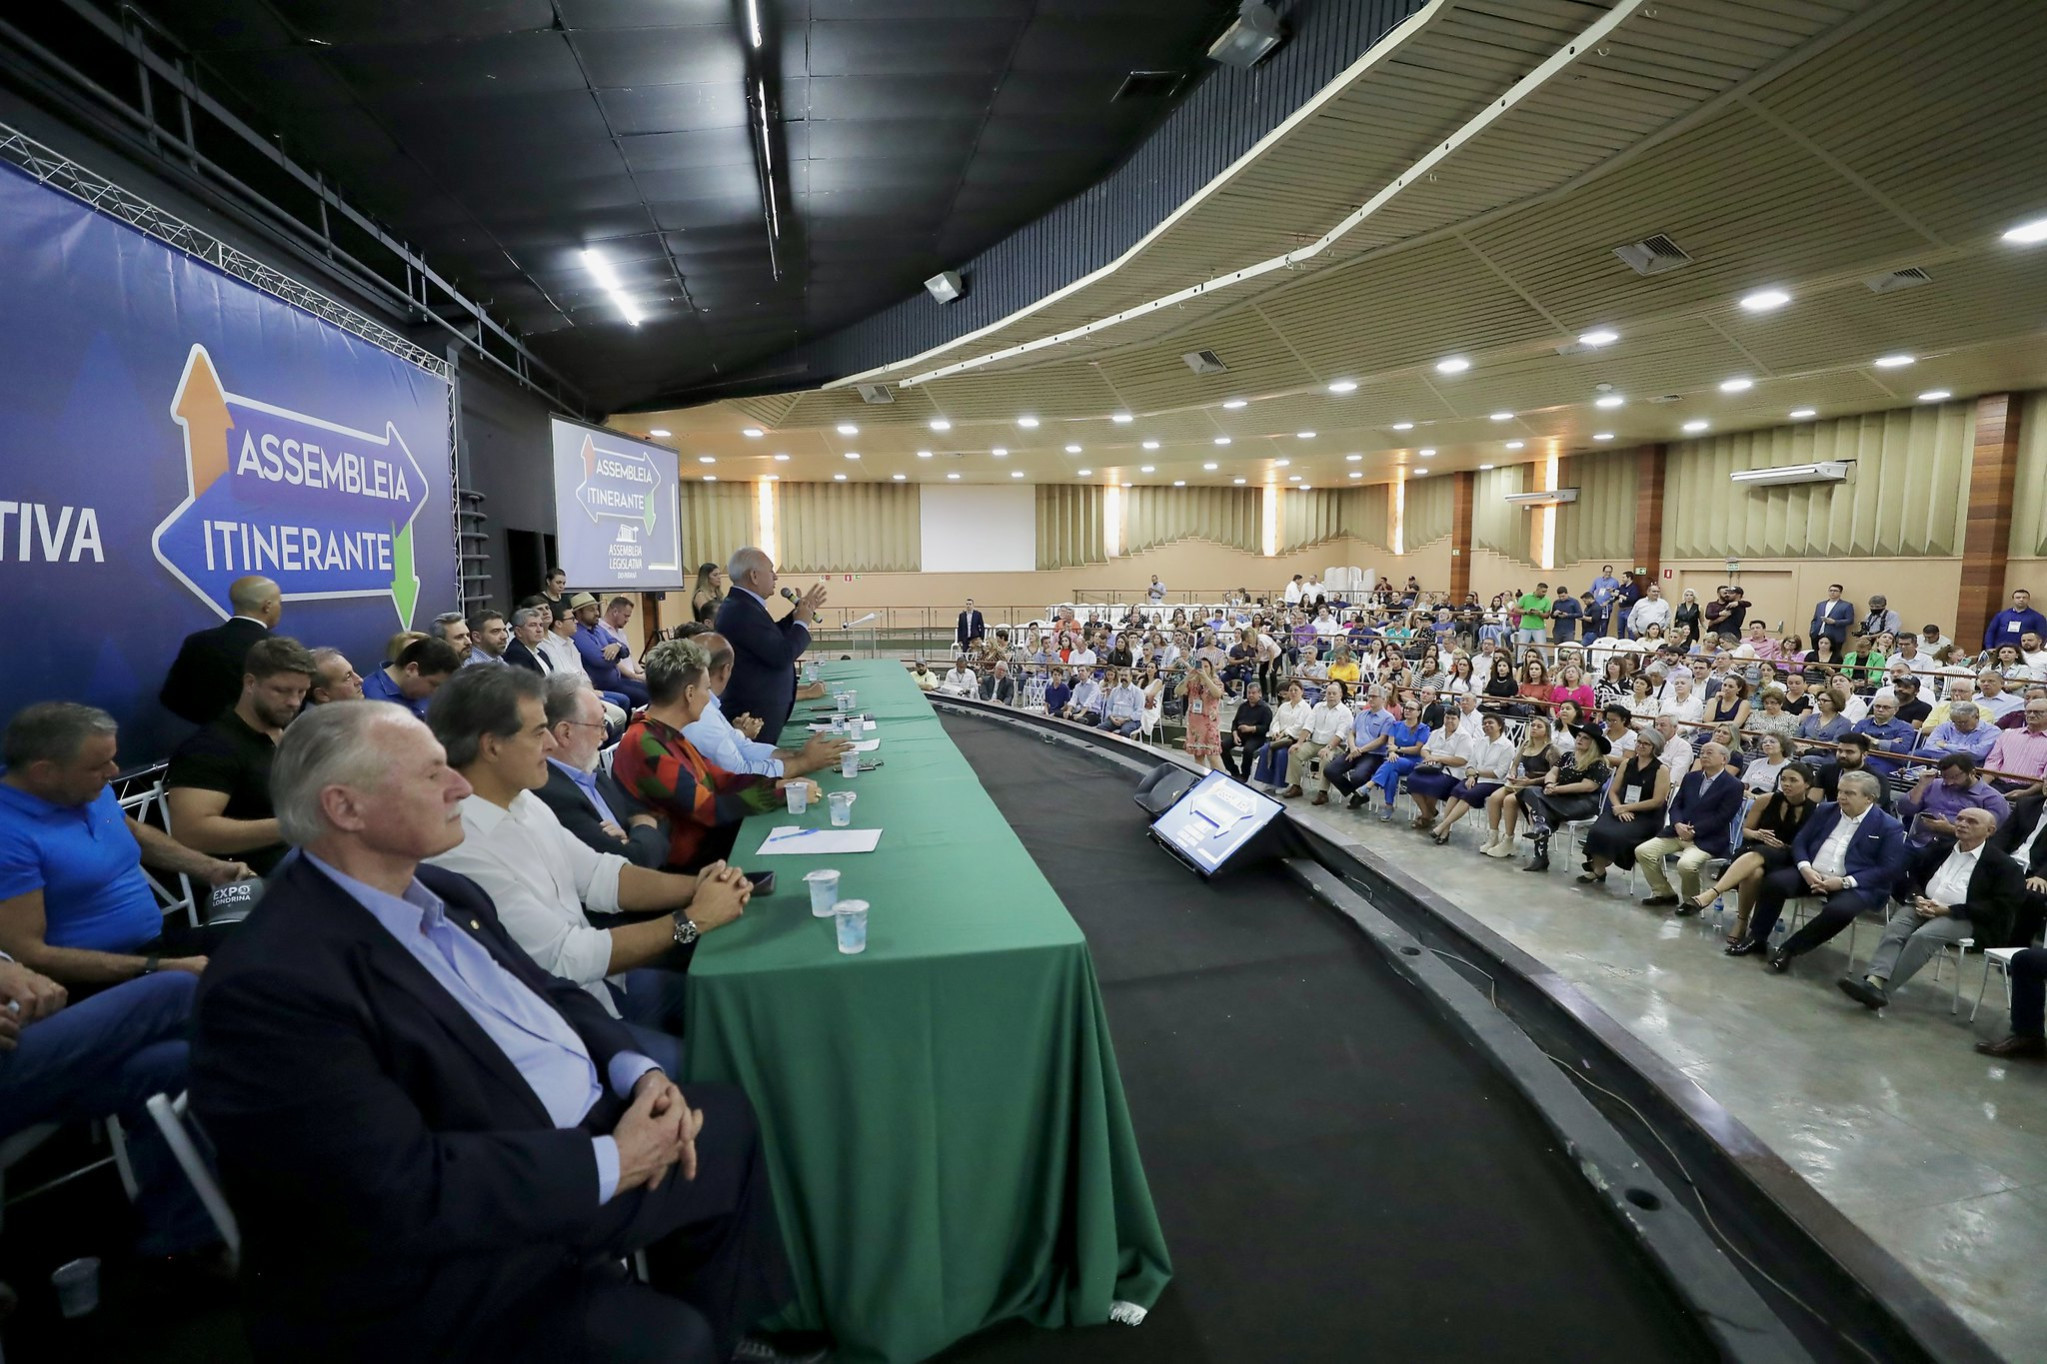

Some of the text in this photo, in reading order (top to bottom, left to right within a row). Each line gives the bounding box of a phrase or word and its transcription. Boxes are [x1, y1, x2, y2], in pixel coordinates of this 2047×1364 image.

[236, 429, 411, 503] ASSEMBLEIA
[596, 459, 652, 484] ASSEMBLEIA
[587, 487, 644, 509] ITINERANTE
[203, 520, 393, 571] ITINERANTE
[212, 895, 250, 906] LONDRINA
